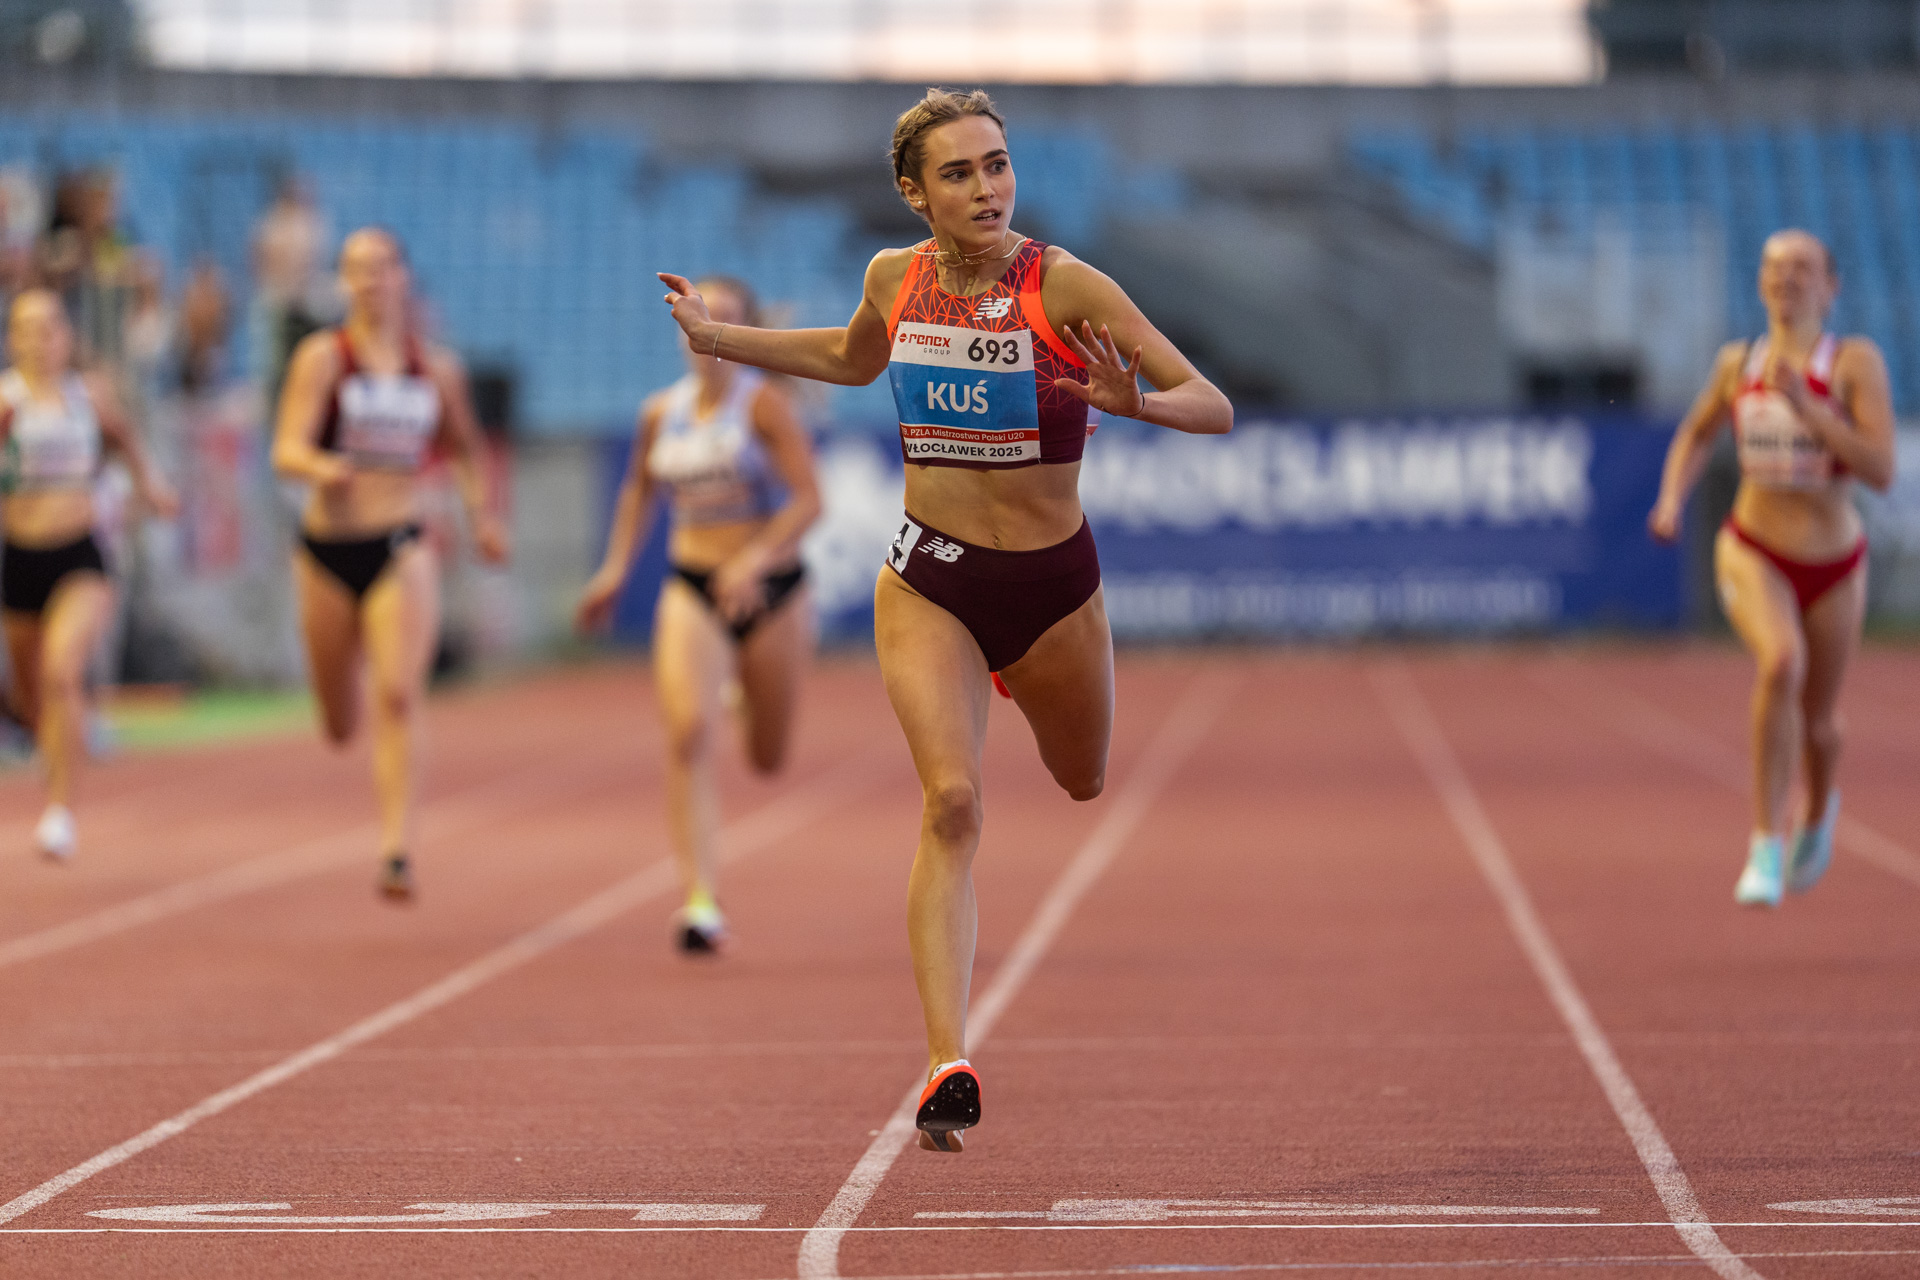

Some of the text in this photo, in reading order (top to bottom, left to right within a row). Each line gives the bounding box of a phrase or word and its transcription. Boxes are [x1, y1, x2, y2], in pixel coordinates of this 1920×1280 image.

[923, 347, 951, 355] GROUP
[968, 337, 1020, 365] 693
[927, 379, 989, 415] KUŚ
[910, 428, 931, 436] PZLA
[932, 429, 980, 440] Mistrzostwa
[981, 433, 1006, 442] Polski
[1007, 431, 1025, 440] U20
[989, 446, 1023, 457] 2025
